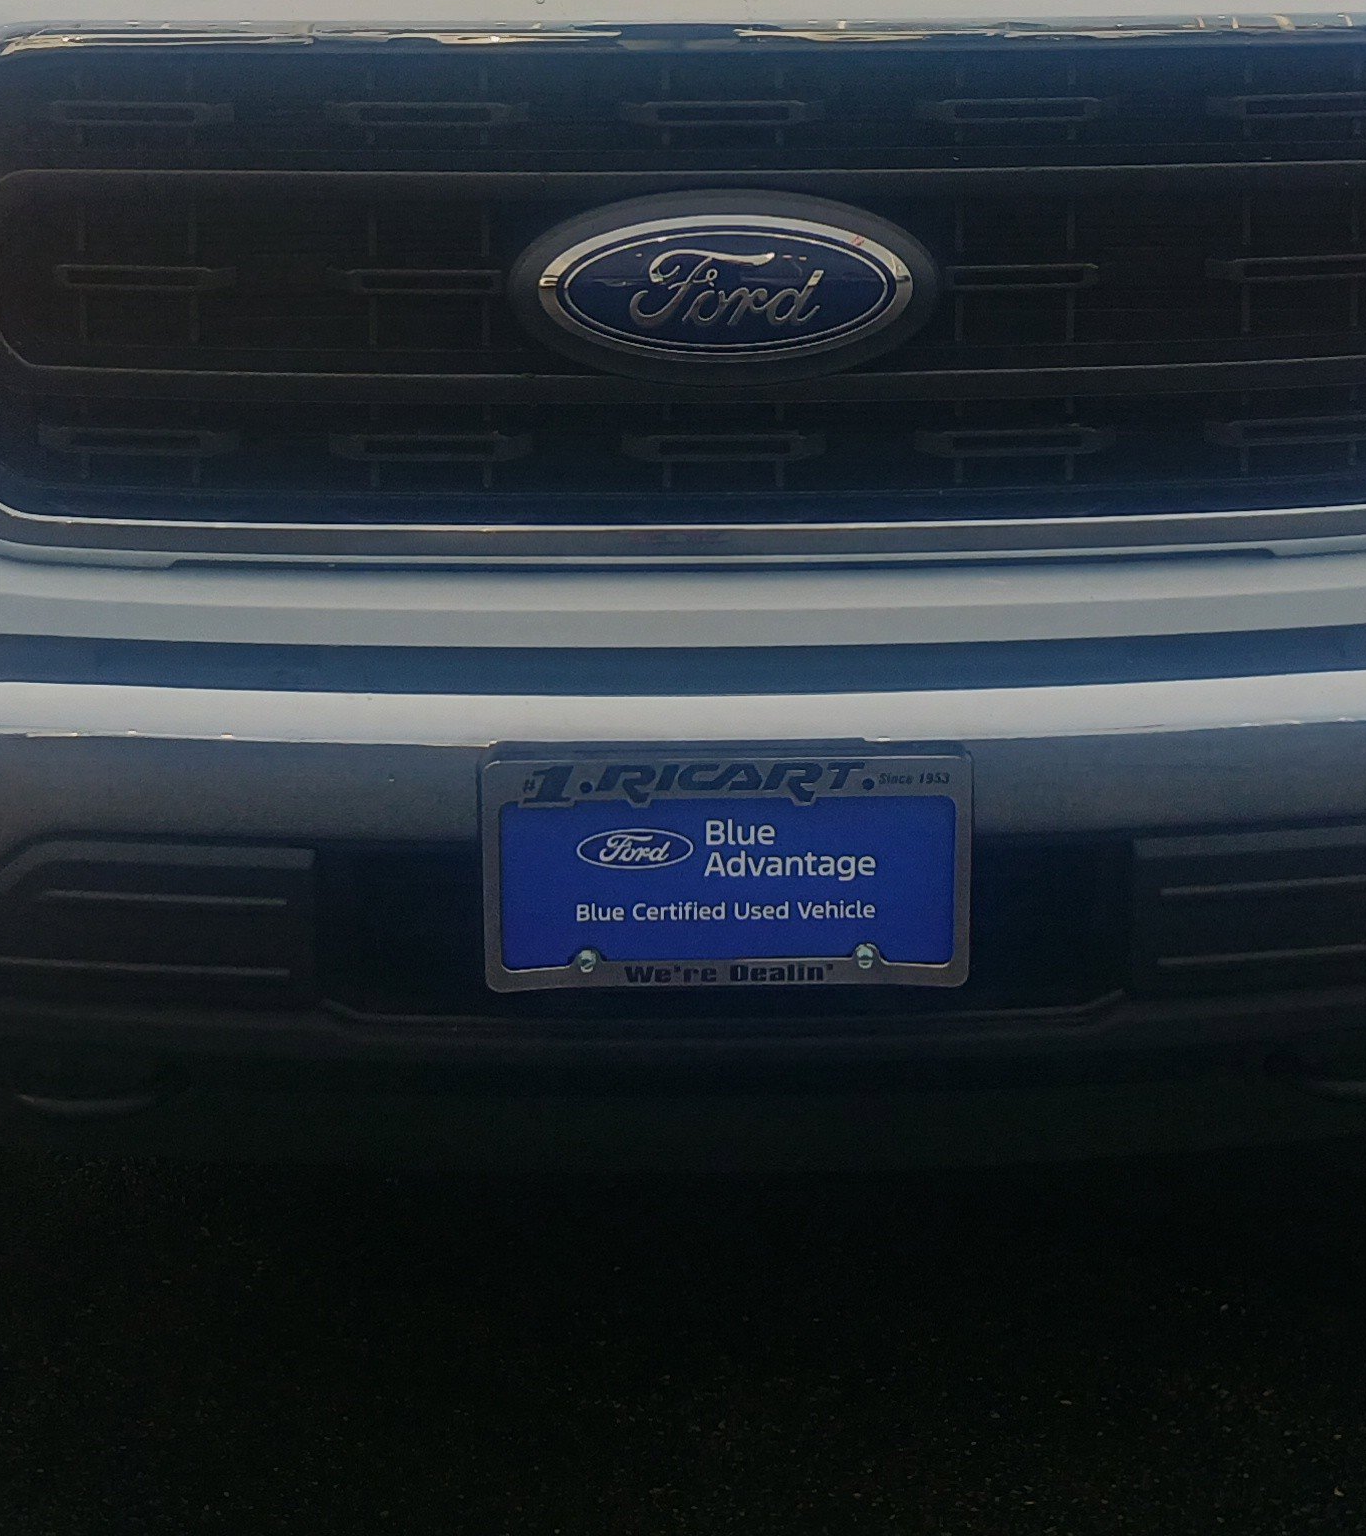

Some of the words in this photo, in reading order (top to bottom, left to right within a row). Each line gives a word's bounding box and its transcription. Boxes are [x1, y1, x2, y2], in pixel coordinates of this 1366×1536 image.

[629, 248, 825, 328] Ford
[598, 830, 670, 863] Ford
[705, 820, 776, 846] Blue
[704, 852, 876, 881] Advantage
[576, 904, 625, 922] Blue
[632, 902, 726, 921] Certified
[734, 902, 790, 919] Used
[797, 901, 876, 919] Vehicle
[624, 965, 717, 983] We're
[729, 964, 834, 982] Dealin'
